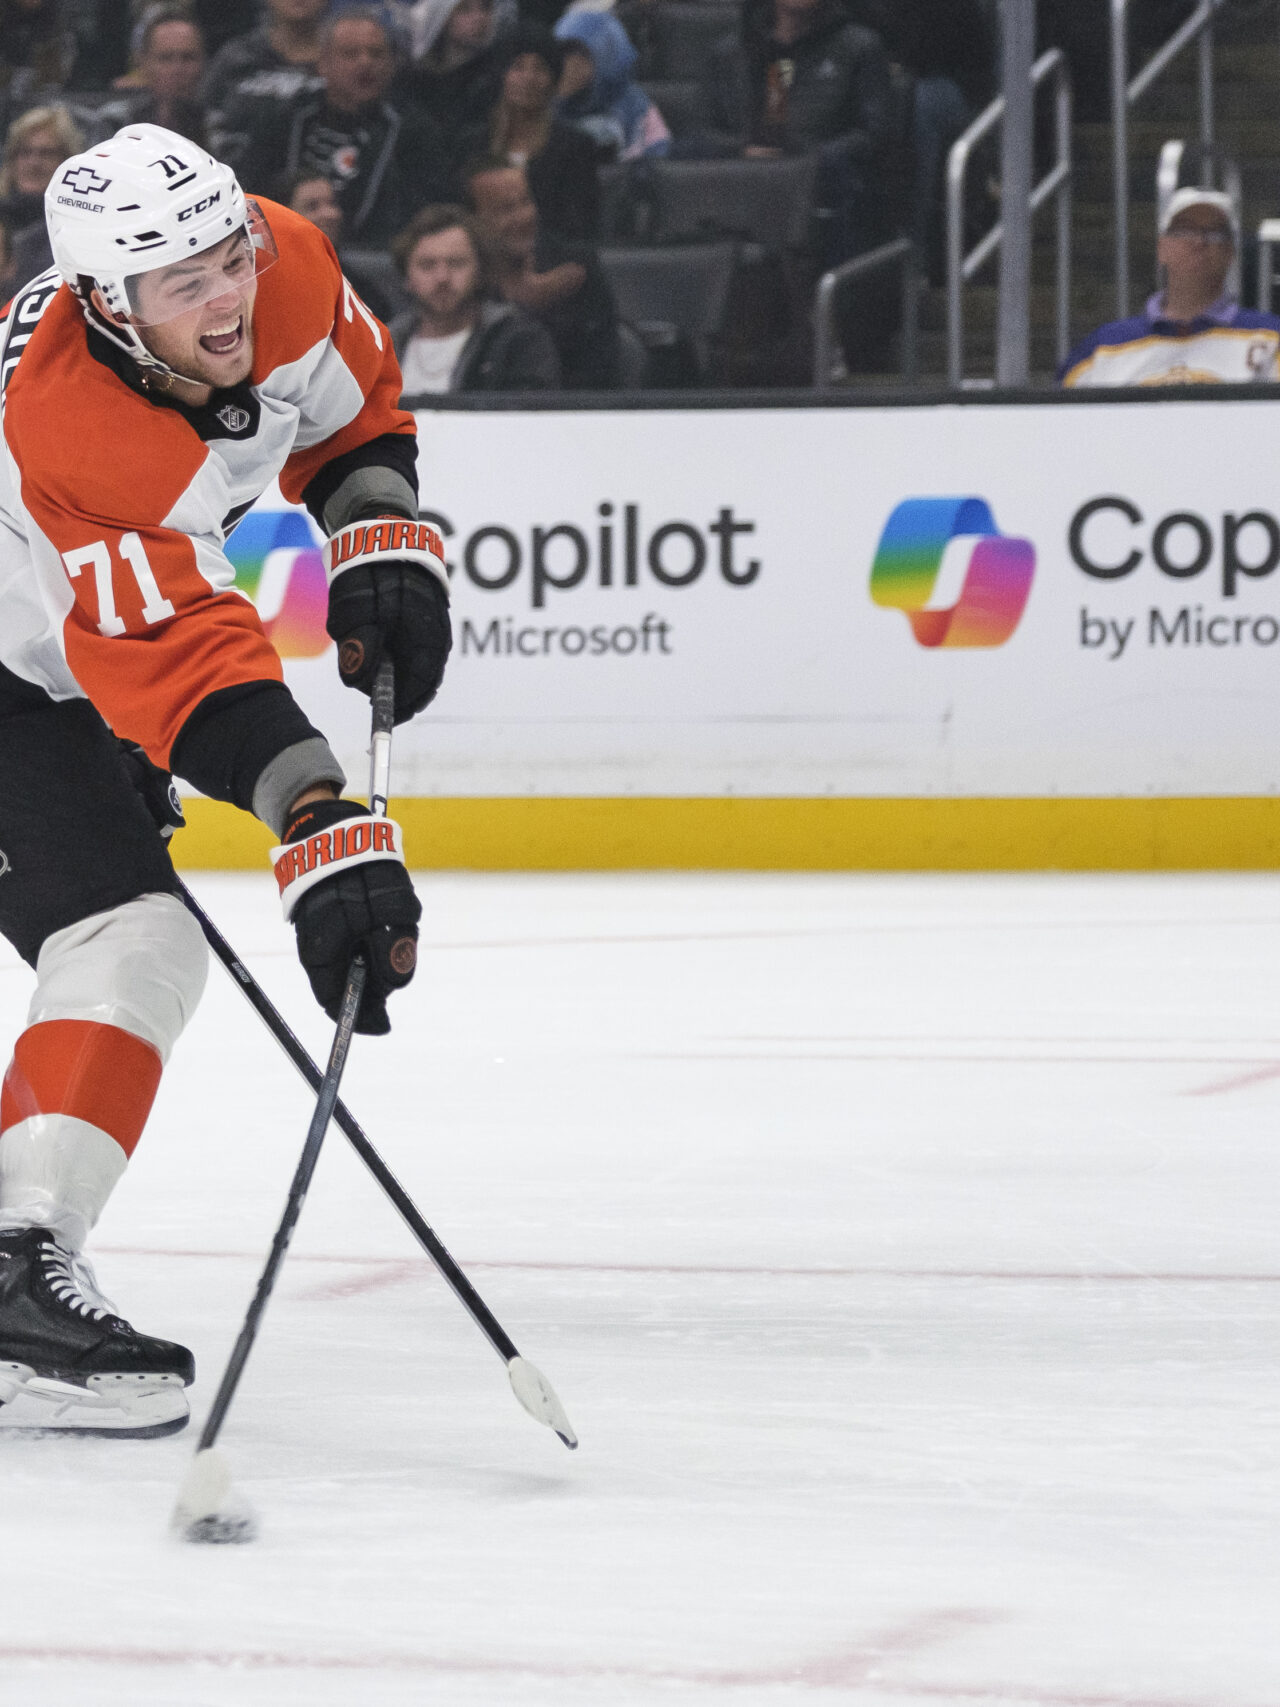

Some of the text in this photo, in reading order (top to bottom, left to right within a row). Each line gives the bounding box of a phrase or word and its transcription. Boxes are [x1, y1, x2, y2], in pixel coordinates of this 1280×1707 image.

[147, 154, 189, 178] 71
[56, 195, 106, 214] CHEVROLET
[176, 190, 221, 222] CCM
[341, 273, 384, 352] 7
[1068, 496, 1280, 597] Cop
[61, 531, 176, 638] 71
[461, 612, 668, 656] Microsoft
[1080, 604, 1280, 660] by Micro
